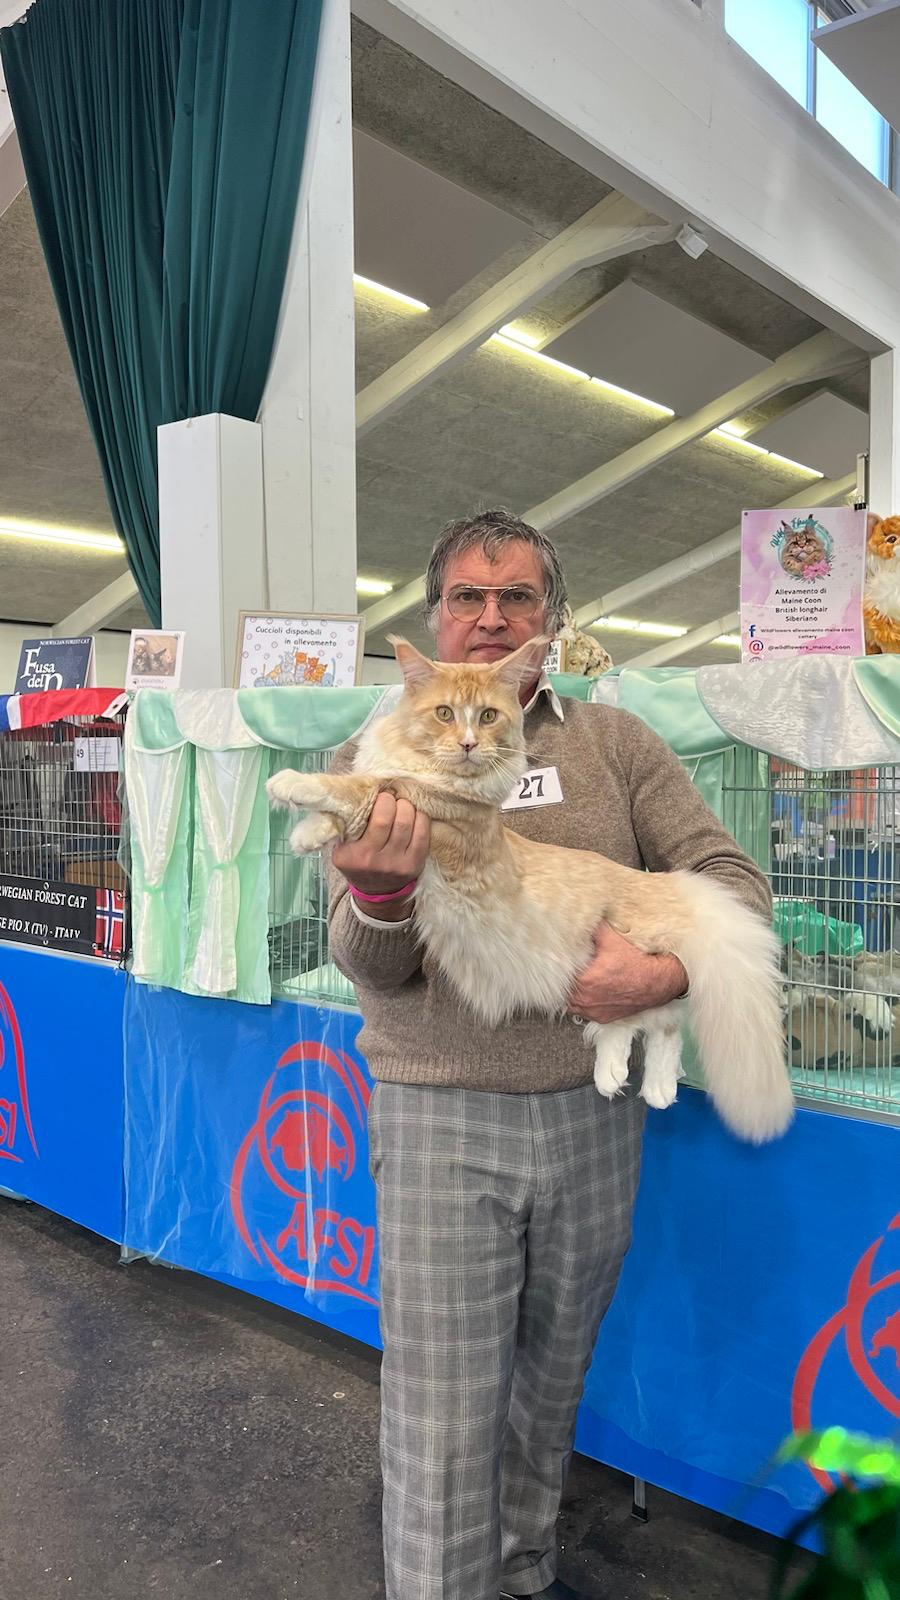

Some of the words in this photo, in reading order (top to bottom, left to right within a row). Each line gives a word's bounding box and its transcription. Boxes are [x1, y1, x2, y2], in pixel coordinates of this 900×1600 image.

[799, 606, 828, 614] longhair
[255, 626, 283, 634] Cuccioli
[285, 627, 322, 636] disponibili
[293, 638, 337, 647] allevamento
[20, 647, 56, 679] Fusa
[516, 775, 545, 799] 27
[34, 890, 66, 906] FOREST
[67, 894, 88, 909] CAT
[8, 919, 23, 932] PIO
[23, 921, 30, 933] X
[31, 922, 49, 937] (TV)
[276, 1201, 375, 1287] AFSI
